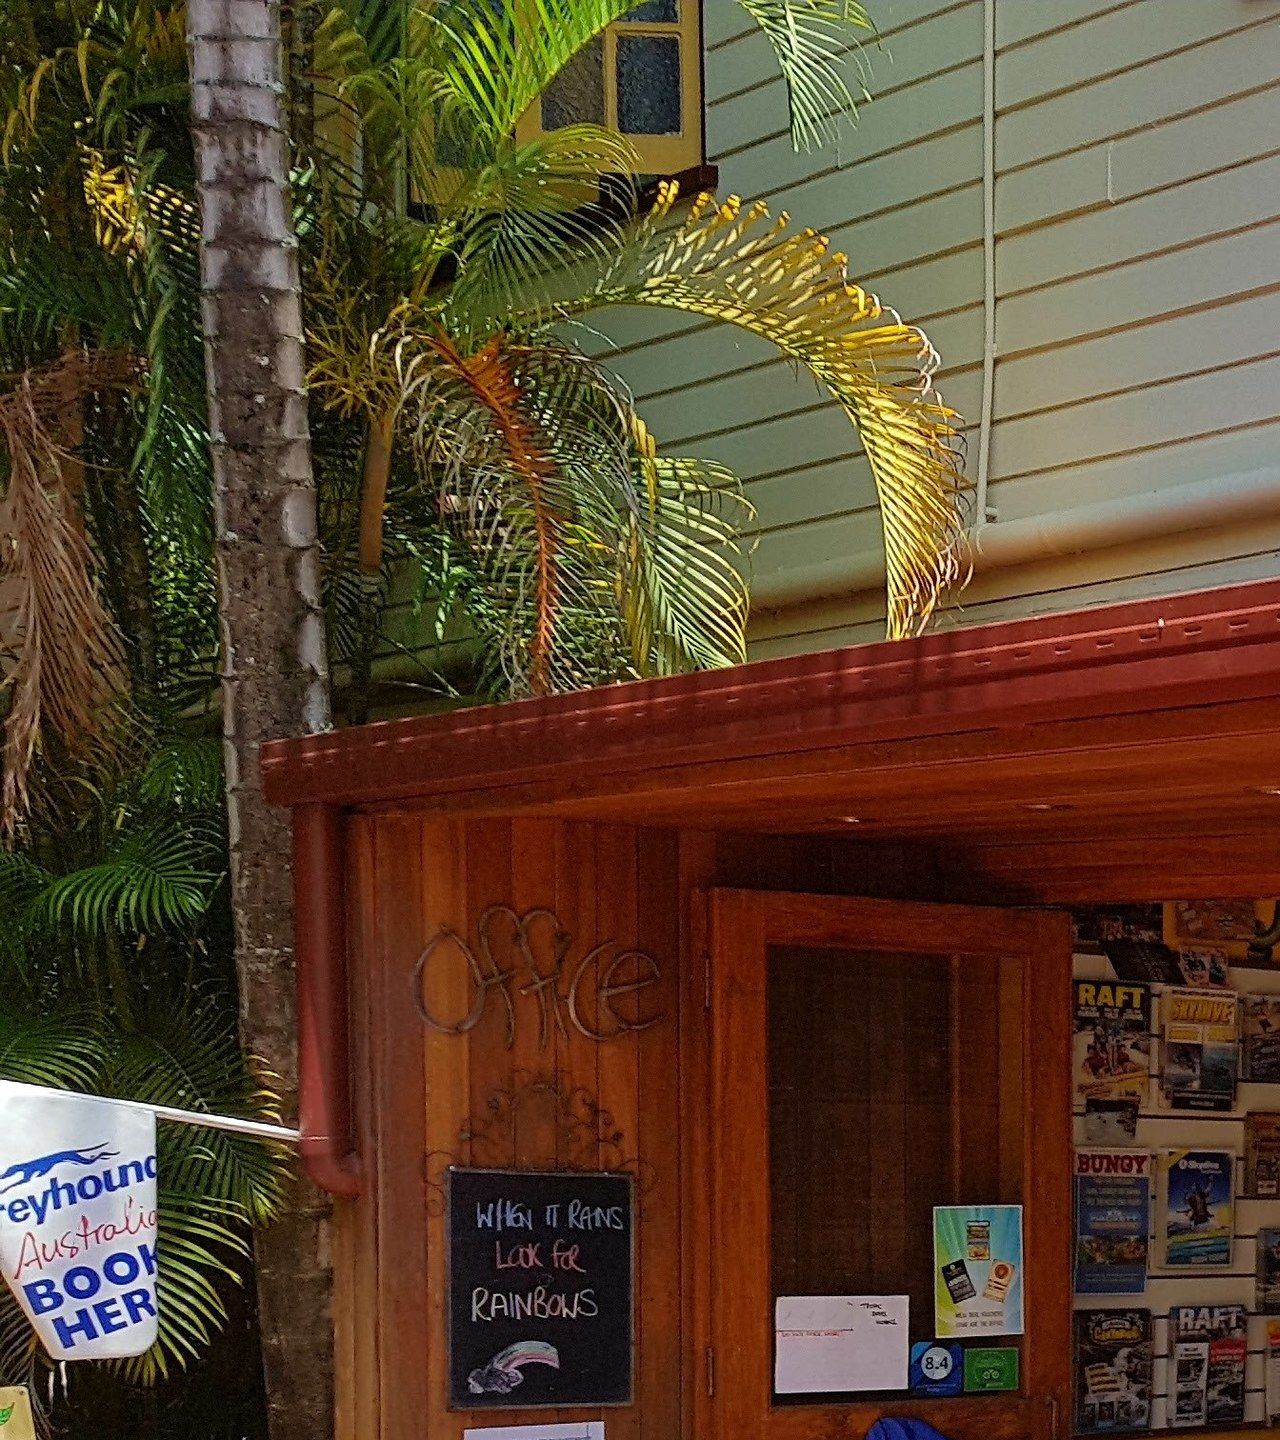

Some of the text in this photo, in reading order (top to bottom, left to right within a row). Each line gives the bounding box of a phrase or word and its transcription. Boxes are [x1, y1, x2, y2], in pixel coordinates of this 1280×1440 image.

[1078, 983, 1146, 1009] RAFT
[476, 1199, 533, 1231] WHEN
[51, 1283, 157, 1349] HER
[471, 1286, 599, 1323] RAINBOWS
[1178, 1306, 1242, 1330] RAFT
[925, 1356, 949, 1370] 8.4
